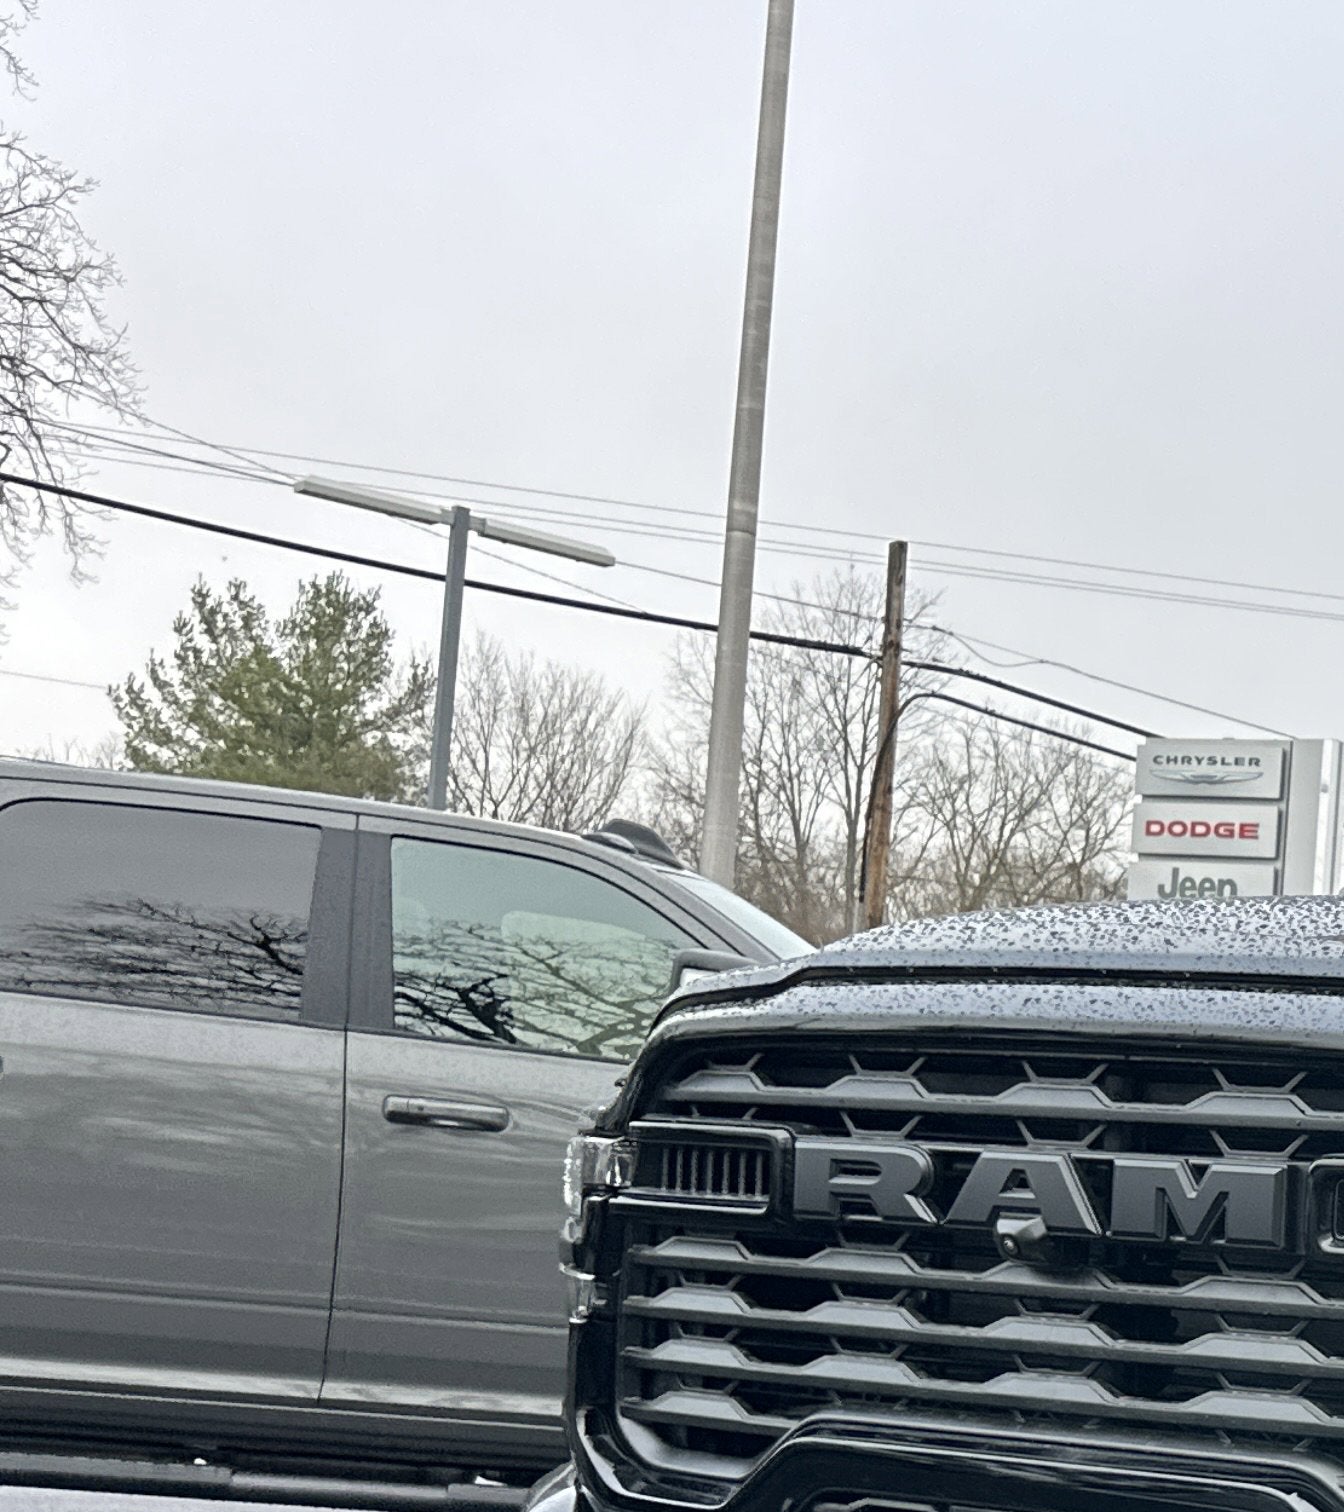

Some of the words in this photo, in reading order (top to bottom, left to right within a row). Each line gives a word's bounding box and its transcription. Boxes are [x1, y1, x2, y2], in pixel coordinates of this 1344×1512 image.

[1152, 754, 1261, 768] CHRYSLER
[1145, 820, 1260, 840] DODGE
[794, 1140, 1287, 1249] RAM
